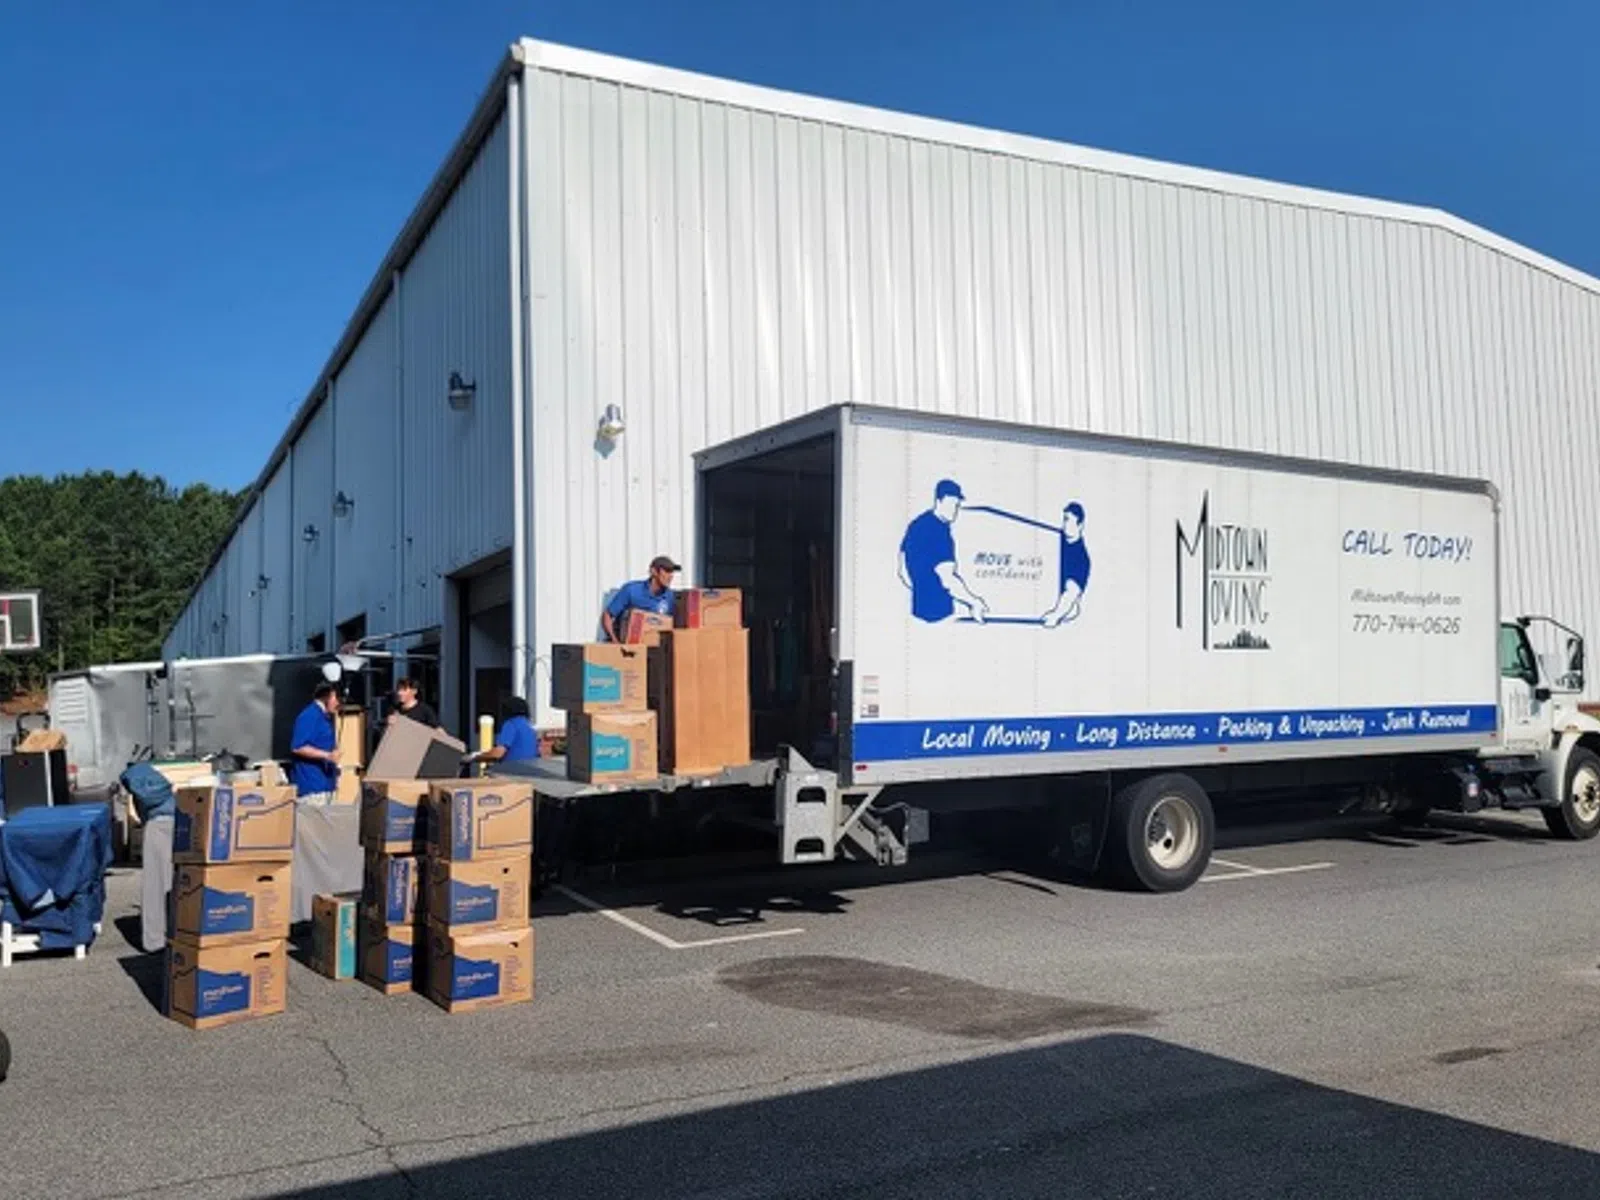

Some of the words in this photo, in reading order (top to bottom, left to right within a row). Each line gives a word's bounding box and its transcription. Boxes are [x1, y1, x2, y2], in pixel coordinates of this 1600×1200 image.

[974, 552, 1012, 566] MOVE
[1342, 530, 1393, 555] CALL
[1403, 532, 1473, 564] TODAY!
[1352, 614, 1461, 634] 770-744-0626
[922, 726, 975, 749] Local
[982, 725, 1051, 750] Moving
[1076, 722, 1118, 746] Long
[1126, 720, 1197, 741] Distance
[1217, 716, 1273, 740] Packing
[1278, 715, 1292, 735] &
[1300, 713, 1365, 737] Unpacking
[1382, 711, 1415, 732] Junk
[1419, 709, 1471, 729] Removal
